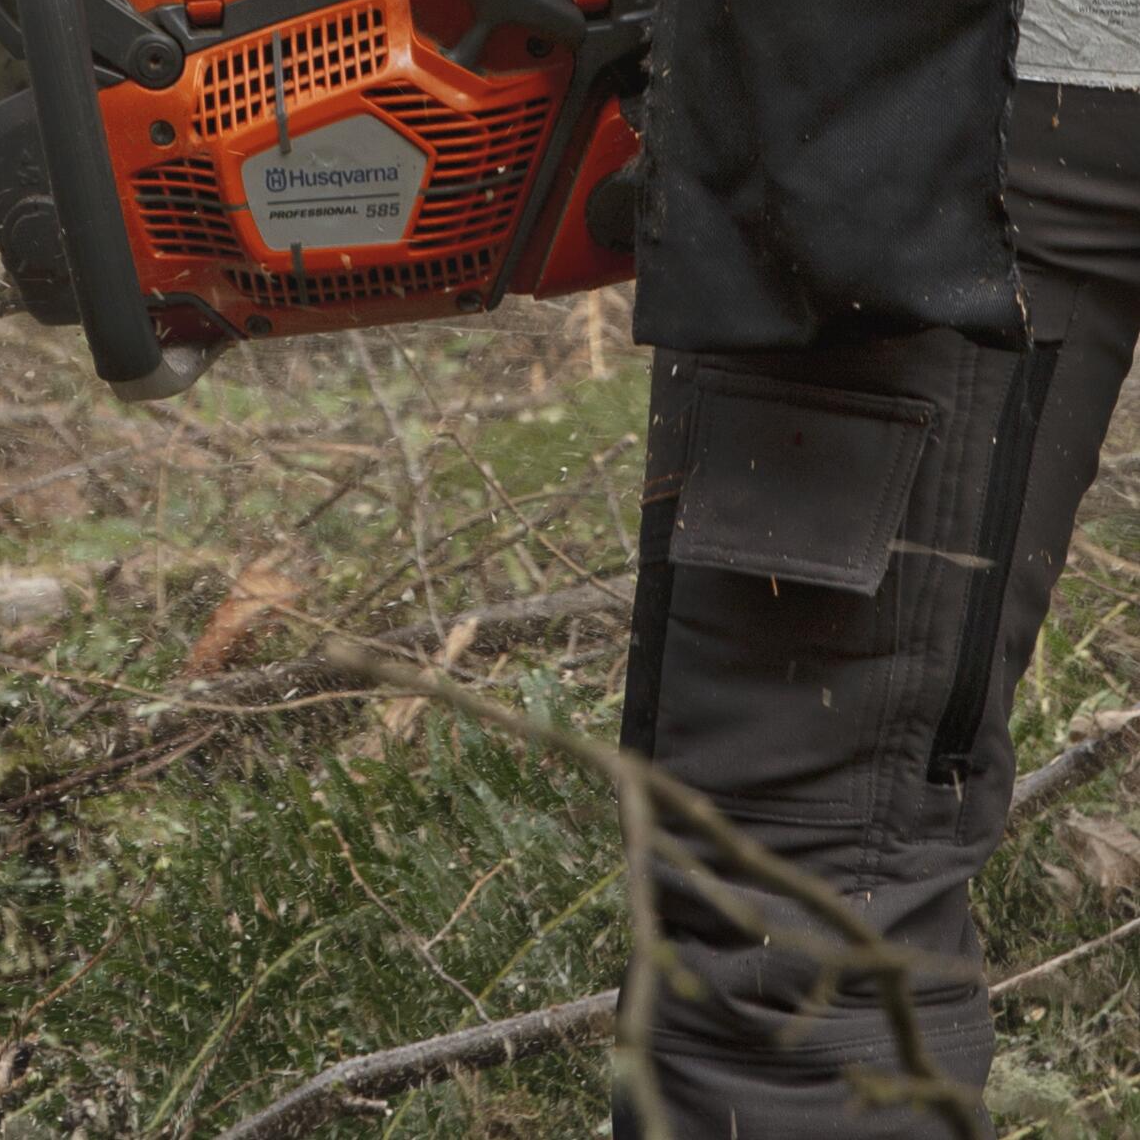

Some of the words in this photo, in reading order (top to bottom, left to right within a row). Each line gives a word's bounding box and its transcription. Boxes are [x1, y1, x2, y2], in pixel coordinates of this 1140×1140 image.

[289, 166, 398, 187] Husqvarna
[269, 206, 359, 220] PROFESSIONAL
[365, 203, 400, 219] 585
